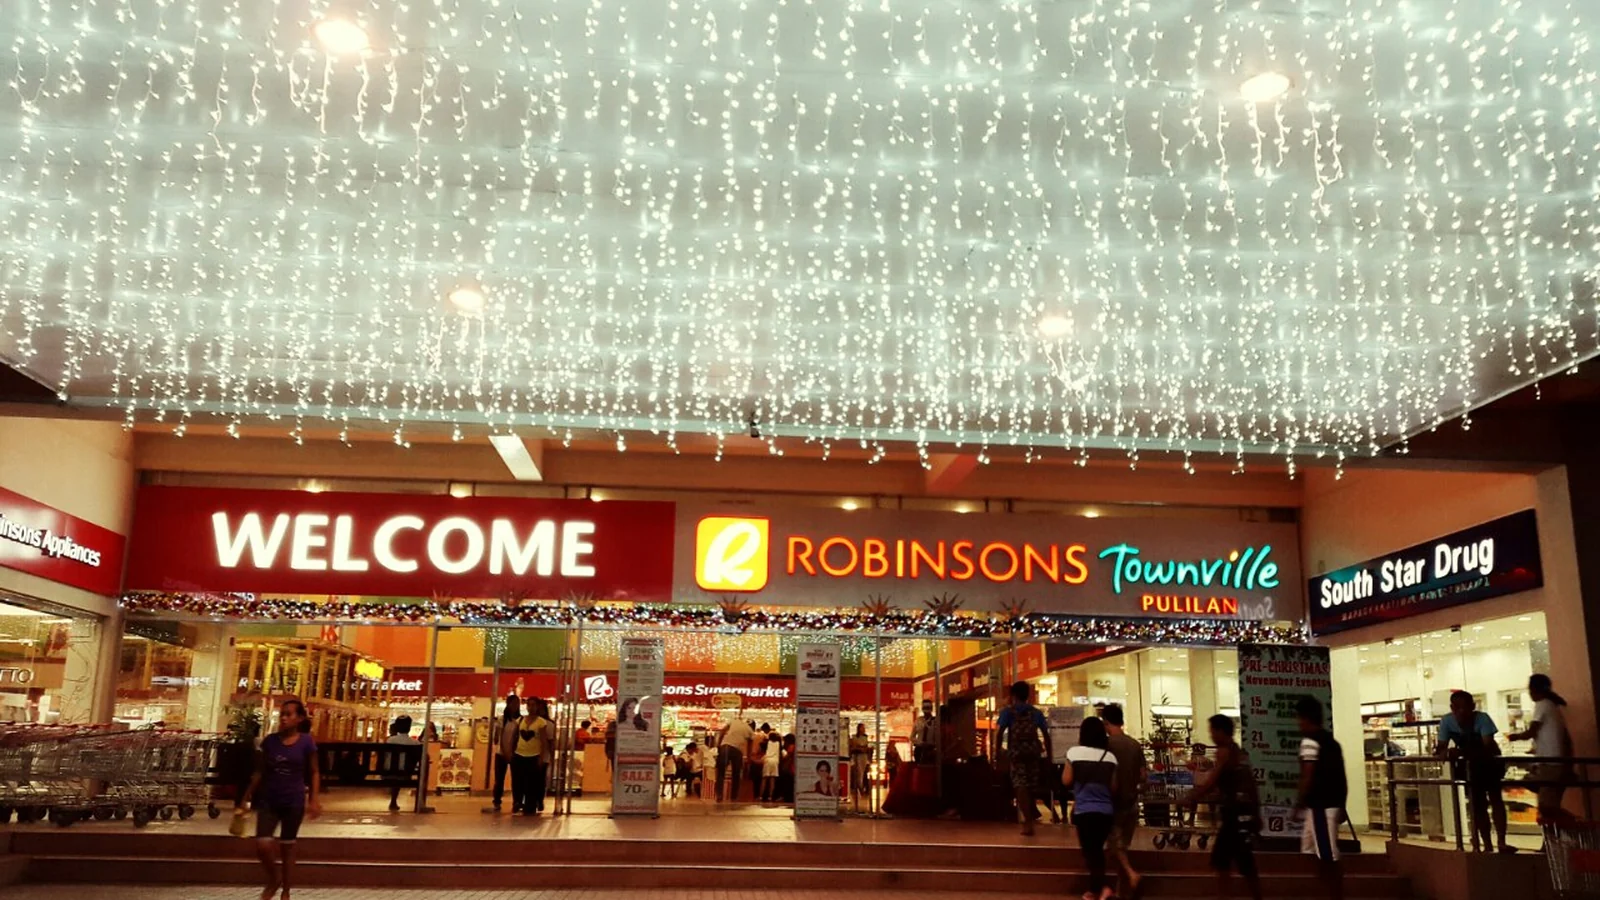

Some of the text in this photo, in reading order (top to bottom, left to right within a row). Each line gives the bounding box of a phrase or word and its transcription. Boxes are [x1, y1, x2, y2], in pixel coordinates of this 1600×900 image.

[0, 513, 102, 567] insons Appliances
[211, 511, 597, 578] WELCOME
[786, 534, 1280, 595] ROBINSONS Townville
[1320, 568, 1374, 609] South
[1380, 557, 1426, 593] Star
[1434, 537, 1495, 579] Drug
[1141, 594, 1239, 615] PULILAN
[695, 683, 790, 698] Supermarket
[1250, 696, 1262, 707] 15
[621, 770, 653, 782] SALE
